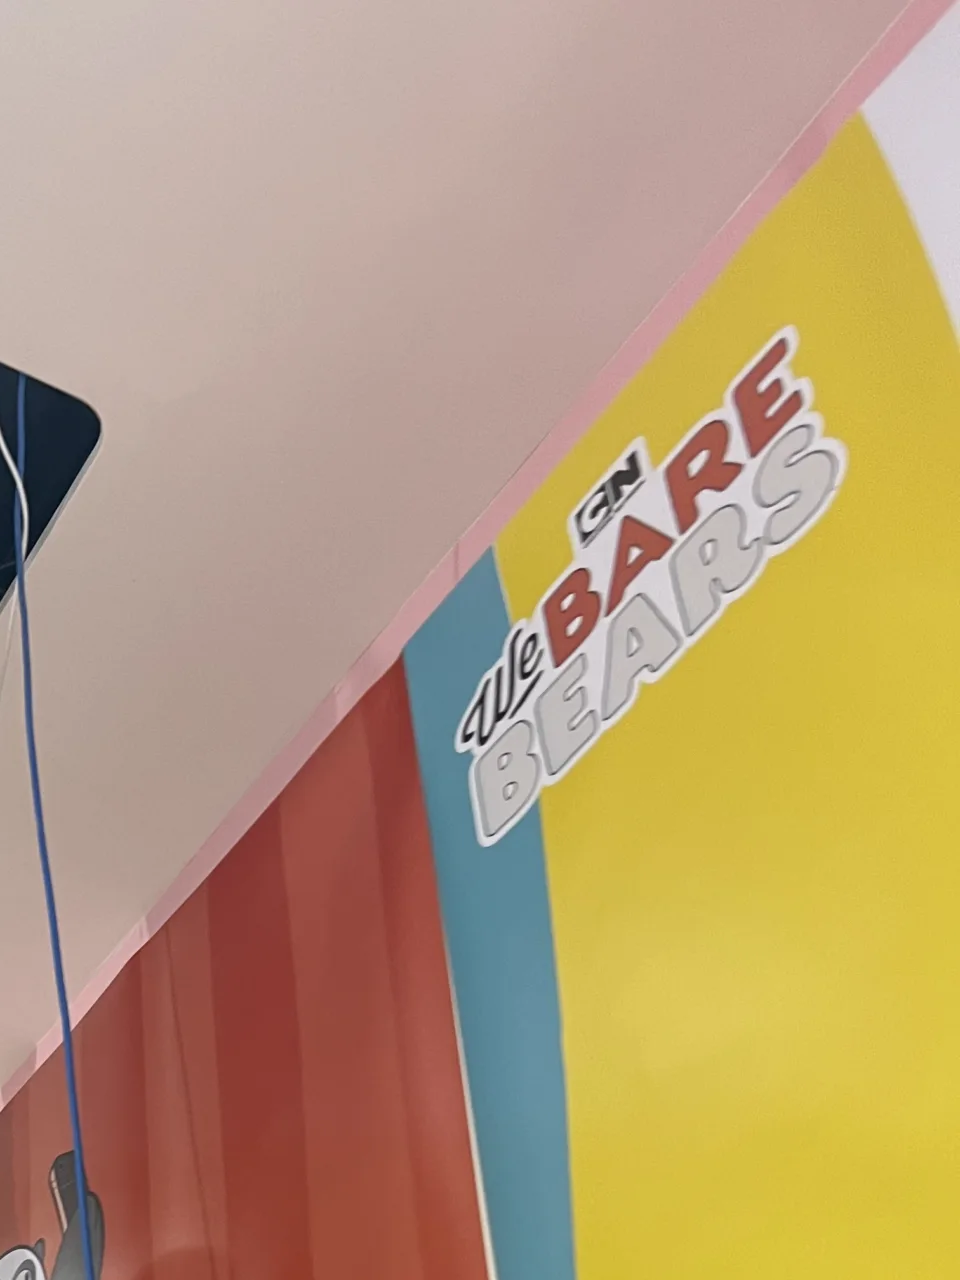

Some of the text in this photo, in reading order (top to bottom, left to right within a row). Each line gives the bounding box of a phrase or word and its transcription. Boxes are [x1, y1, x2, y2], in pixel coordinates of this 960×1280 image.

[461, 337, 805, 746] We BARE
[474, 423, 840, 838] BEARS
